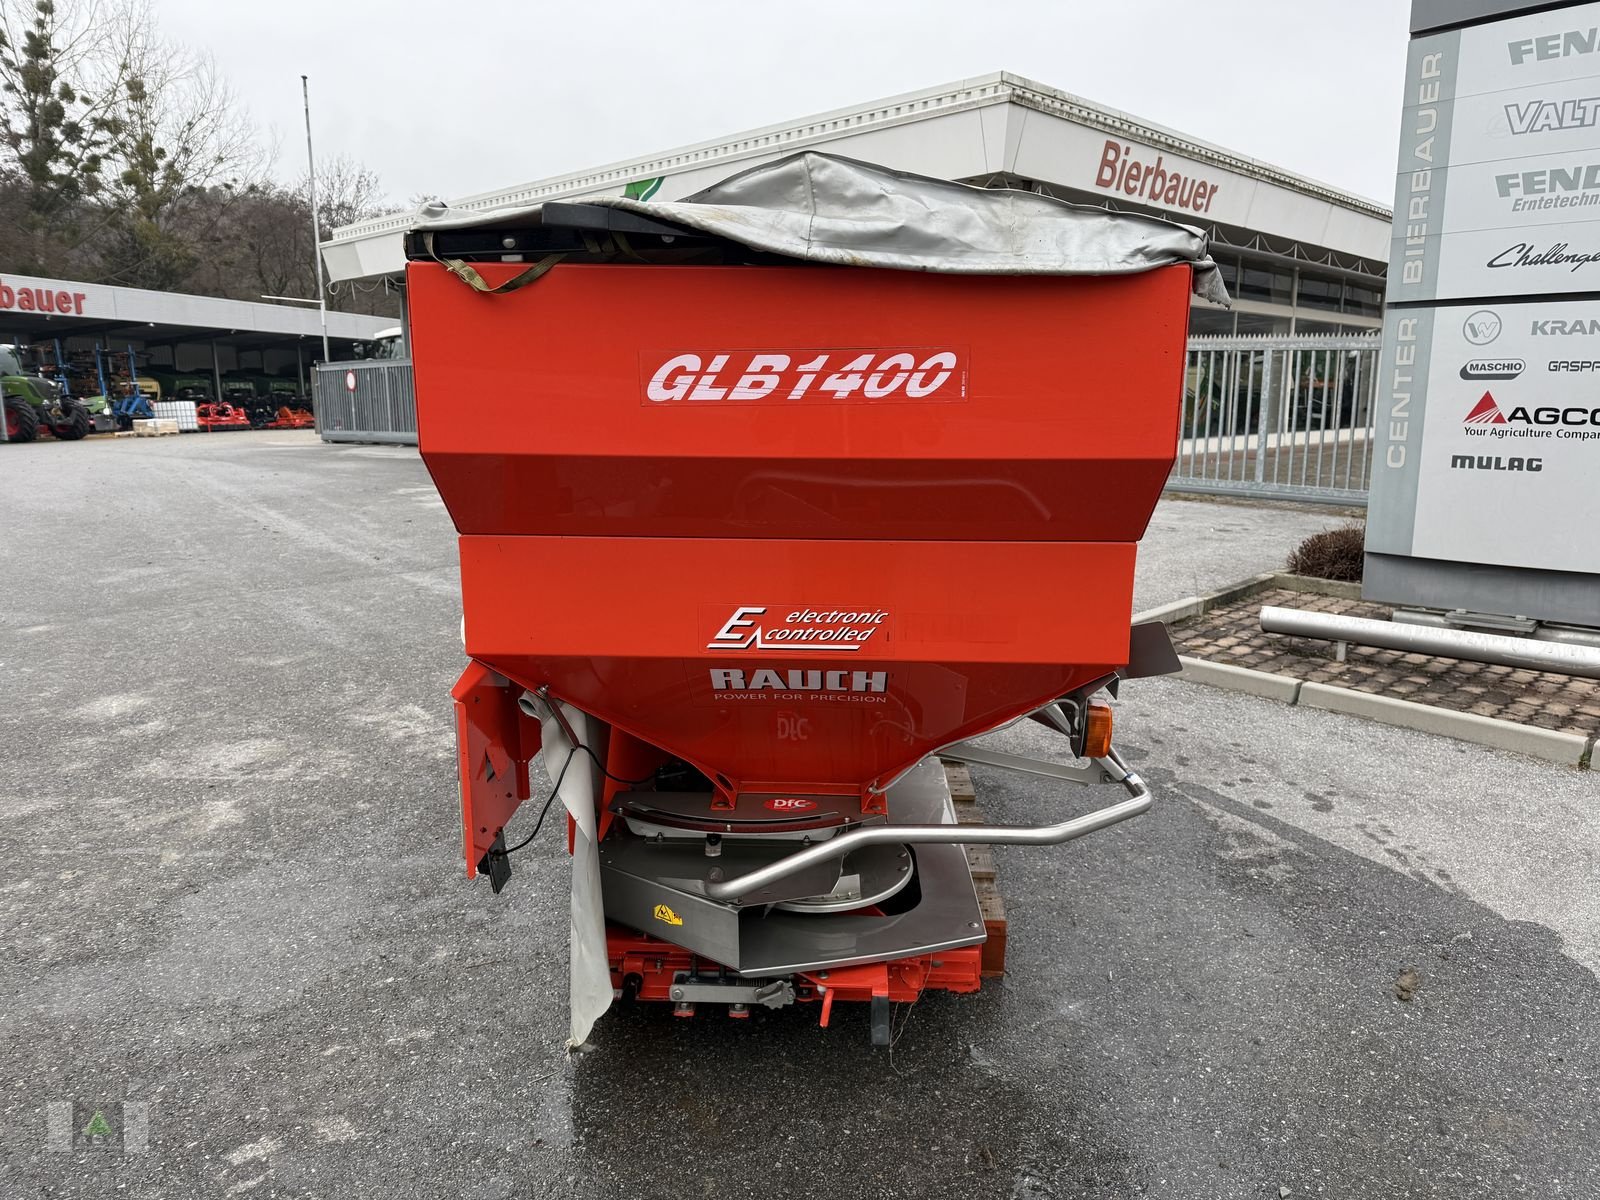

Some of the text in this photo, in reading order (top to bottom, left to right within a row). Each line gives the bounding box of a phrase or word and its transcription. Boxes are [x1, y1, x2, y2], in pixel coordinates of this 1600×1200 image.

[1507, 27, 1600, 65] FEN
[1096, 140, 1219, 213] Bierbauer
[1402, 51, 1443, 284] BIERBAUER
[1511, 192, 1600, 212] Erntetechn
[0, 278, 86, 315] bauer
[1469, 362, 1522, 372] MASCHIO
[1387, 318, 1418, 469] CENTER
[1464, 426, 1488, 437] Your
[1490, 427, 1553, 440] Agriculture
[785, 608, 889, 624] electronic
[764, 626, 876, 642] controlled
[709, 668, 888, 692] RAUCH
[714, 693, 887, 703] POWER FOR PRECISION
